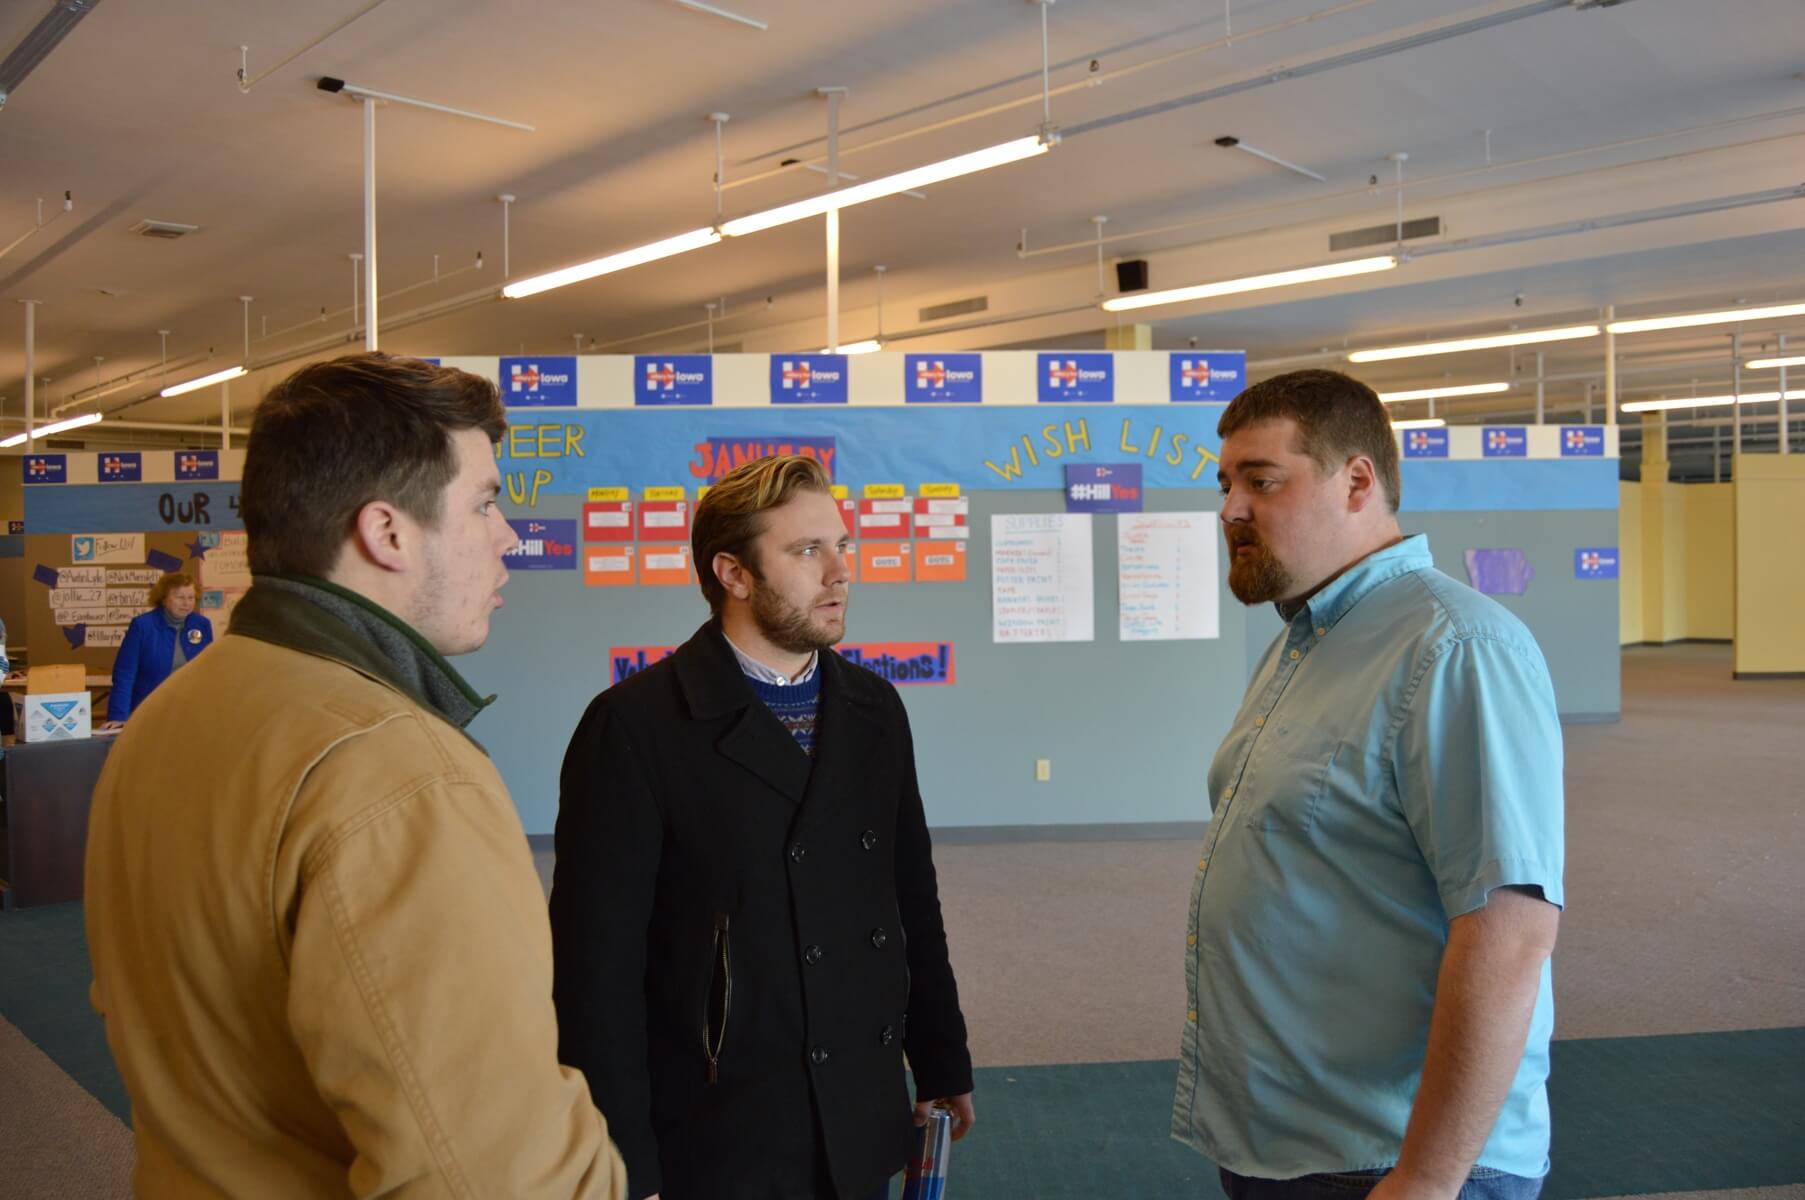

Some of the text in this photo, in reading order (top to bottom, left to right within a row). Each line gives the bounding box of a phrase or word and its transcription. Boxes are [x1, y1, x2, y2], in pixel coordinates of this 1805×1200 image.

[540, 373, 568, 383] Iowa
[676, 371, 703, 381] Iowa
[812, 370, 839, 380] Iowa
[946, 370, 973, 380] Iowa
[1078, 370, 1105, 379] Iowa
[984, 417, 1220, 481] WISH LIST
[506, 469, 552, 507] UP
